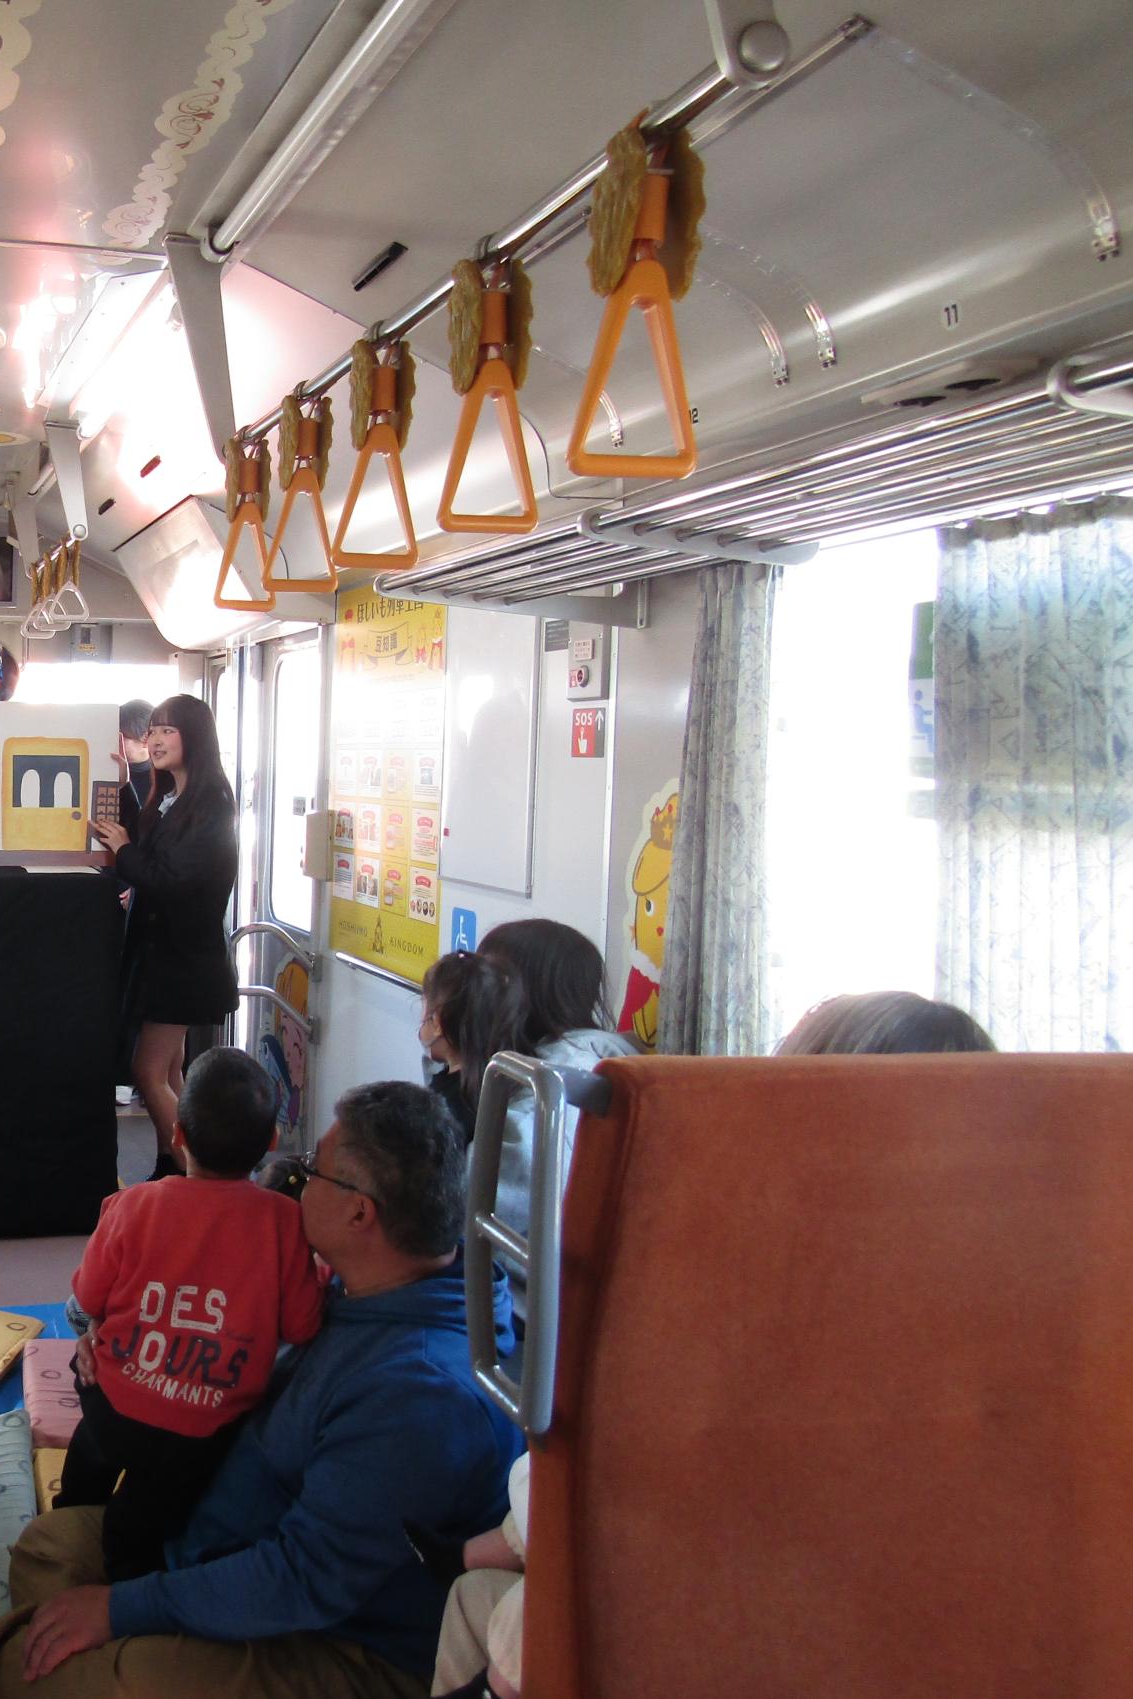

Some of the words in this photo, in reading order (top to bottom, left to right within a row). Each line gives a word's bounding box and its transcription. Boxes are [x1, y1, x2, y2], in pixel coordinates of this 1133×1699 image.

[944, 304, 959, 327] 11
[575, 712, 593, 726] SOS
[389, 936, 424, 956] KINGDOM
[139, 1281, 227, 1333] DES
[111, 1324, 249, 1389] JOURS
[121, 1362, 224, 1408] CHARMANTS
